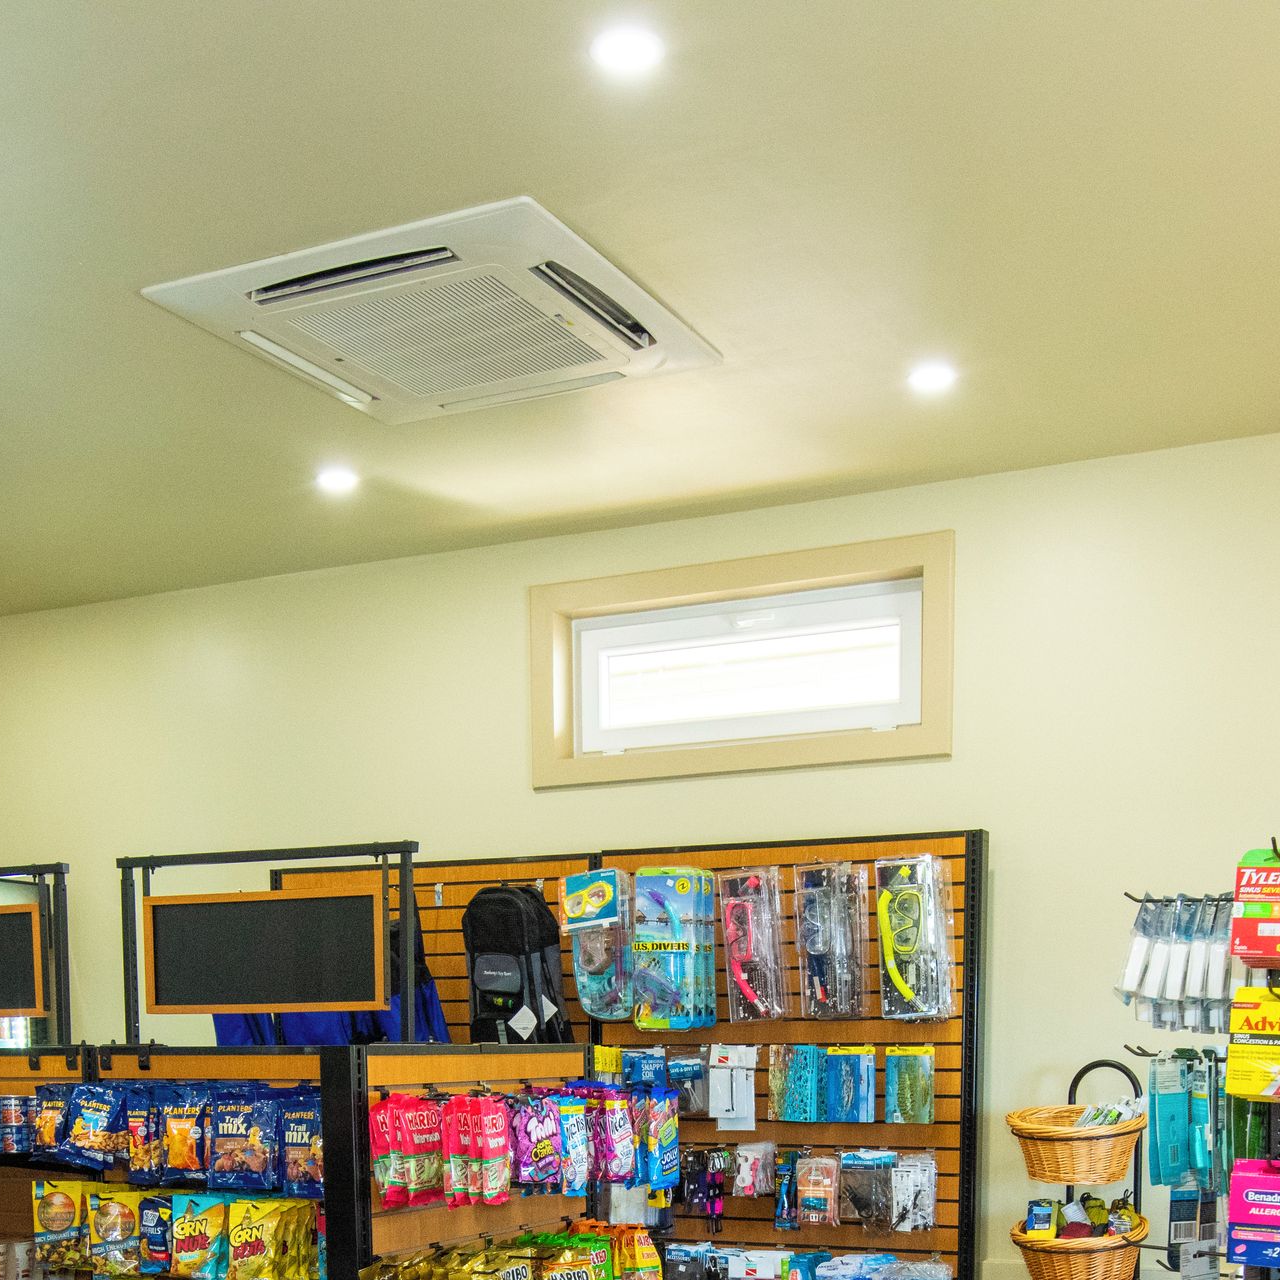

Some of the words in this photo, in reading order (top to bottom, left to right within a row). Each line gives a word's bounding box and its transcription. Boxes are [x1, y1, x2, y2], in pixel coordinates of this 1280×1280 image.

[633, 943, 650, 951] U.S.
[651, 942, 689, 951] DIVERS
[80, 1100, 111, 1112] PLANTERS
[163, 1106, 200, 1115] PLANTERS
[284, 1112, 314, 1120] PLANTERS
[219, 1123, 247, 1135] mix
[290, 1123, 306, 1132] Trail
[285, 1131, 311, 1143] mix
[662, 1148, 678, 1165] JOLLY
[174, 1217, 207, 1239] CORN
[230, 1225, 264, 1246] CORN
[1273, 1247, 1280, 1258] 2
